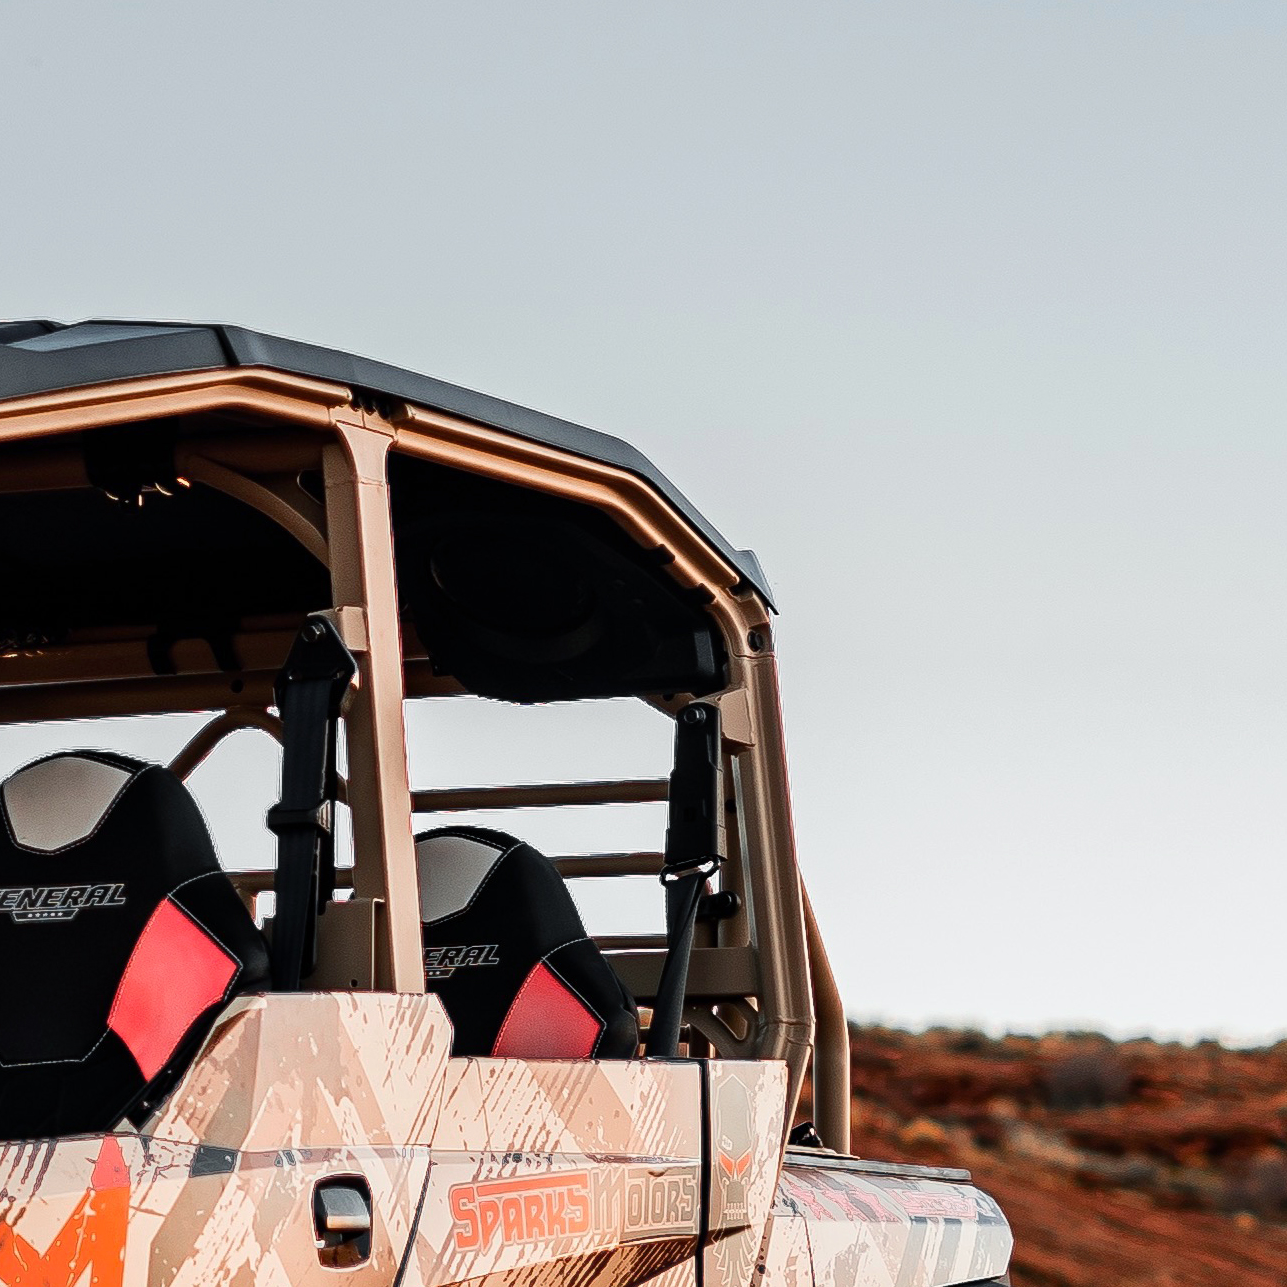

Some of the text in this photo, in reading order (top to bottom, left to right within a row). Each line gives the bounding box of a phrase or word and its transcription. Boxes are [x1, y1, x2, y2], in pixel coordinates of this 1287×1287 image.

[423, 944, 500, 968] ERAL
[450, 1166, 697, 1251] SPARKS MOTORS
